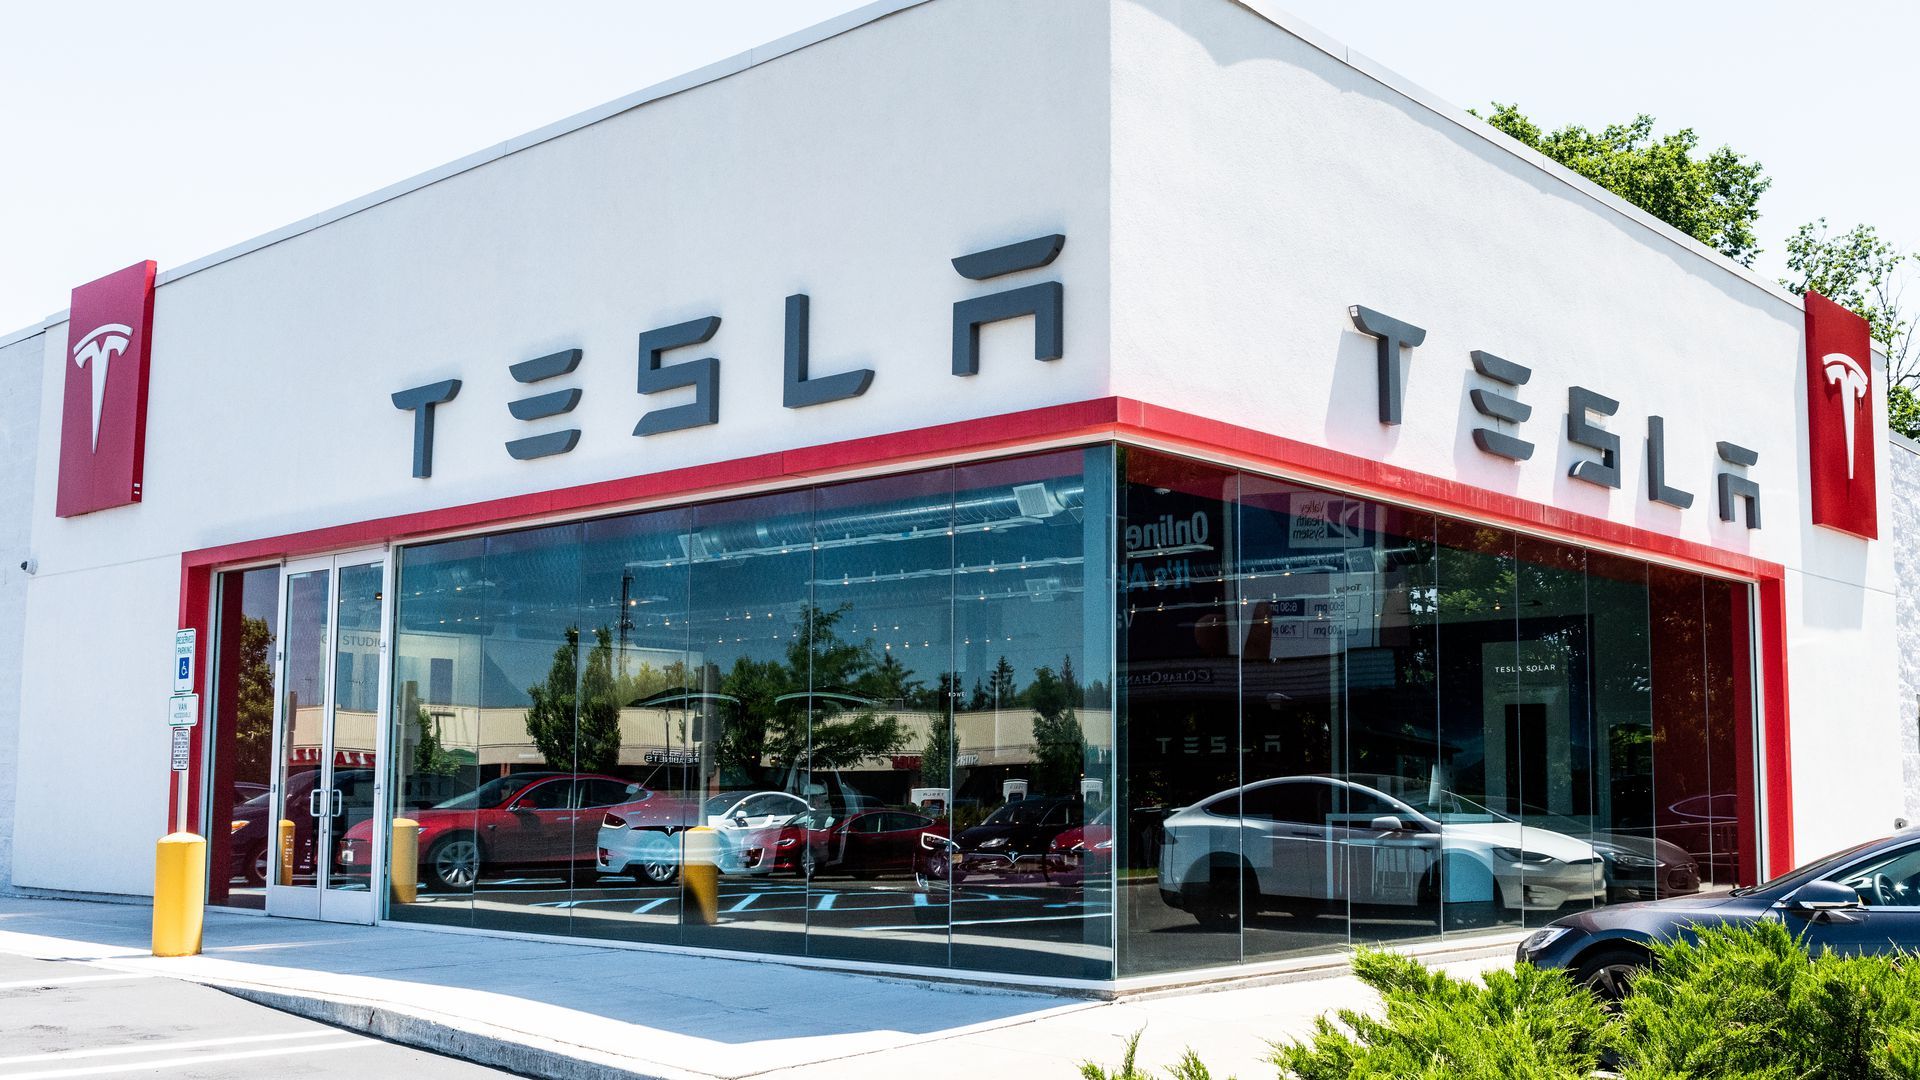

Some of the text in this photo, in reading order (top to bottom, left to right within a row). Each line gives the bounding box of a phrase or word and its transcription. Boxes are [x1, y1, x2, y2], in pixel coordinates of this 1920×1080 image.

[391, 234, 1066, 479] TESLA
[1349, 304, 1761, 530] TESLA
[178, 703, 188, 712] VAN
[1494, 664, 1556, 674] TESLA SOLAR
